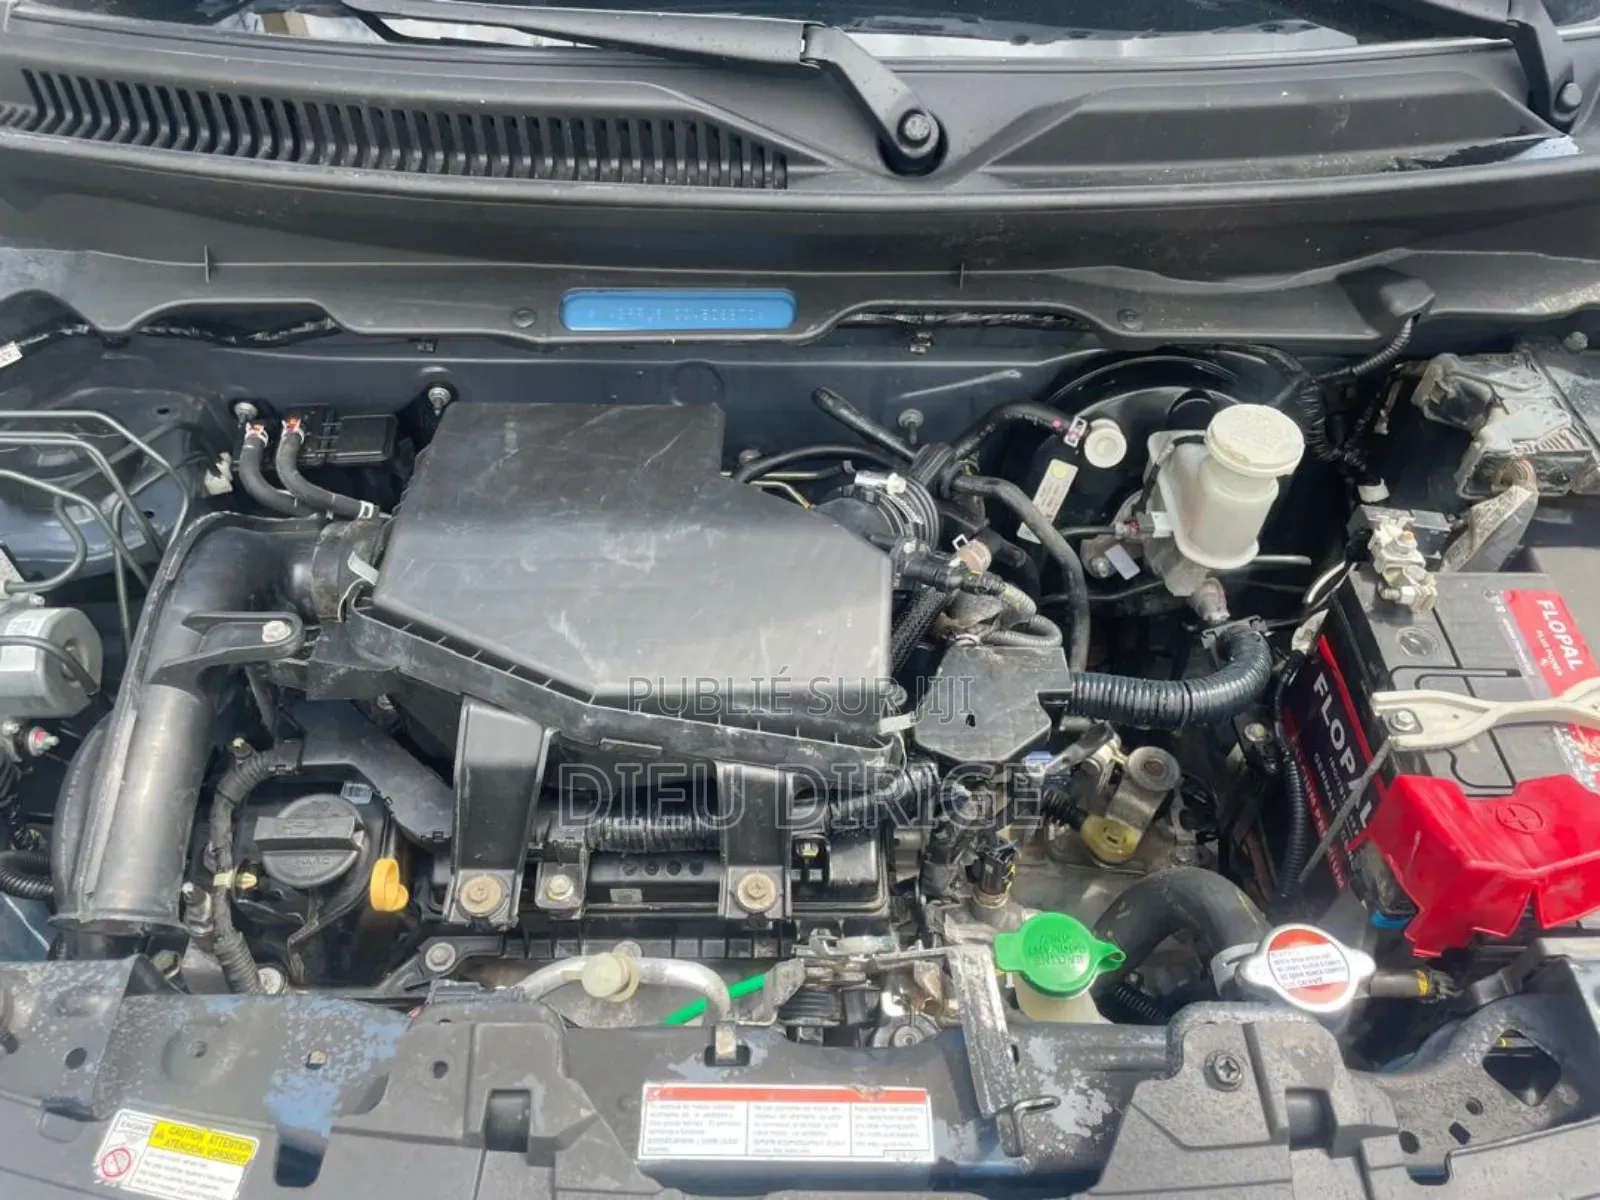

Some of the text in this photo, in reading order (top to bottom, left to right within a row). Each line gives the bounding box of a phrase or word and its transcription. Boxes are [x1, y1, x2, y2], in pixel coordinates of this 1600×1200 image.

[1536, 600, 1583, 671] FLOPAL
[168, 1126, 252, 1152] CAUTION ATTENTION
